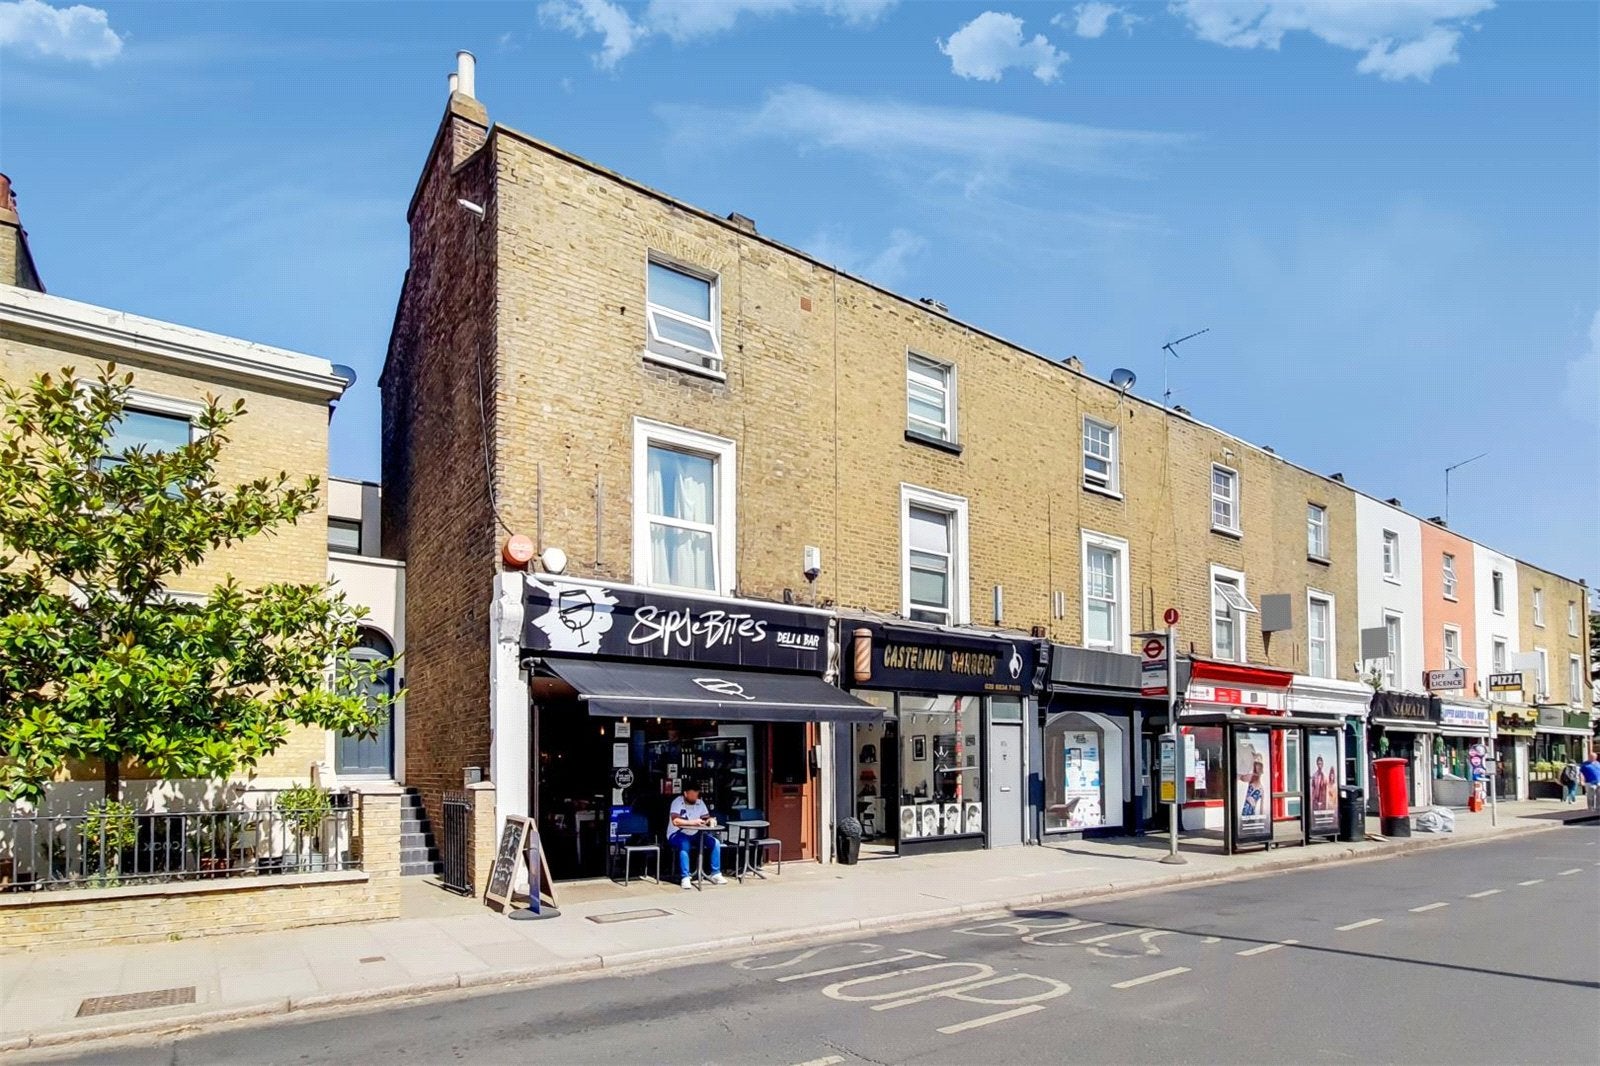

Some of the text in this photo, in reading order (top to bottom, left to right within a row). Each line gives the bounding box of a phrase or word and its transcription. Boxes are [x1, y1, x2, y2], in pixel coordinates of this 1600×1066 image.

[1168, 609, 1174, 622] J
[776, 631, 796, 645] DELI
[803, 633, 820, 647] BAR
[883, 644, 998, 677] CASTELNAU BARBERS
[1490, 675, 1521, 685] PIZZA
[951, 916, 1221, 958] BUS
[730, 942, 1072, 1012] STOP
